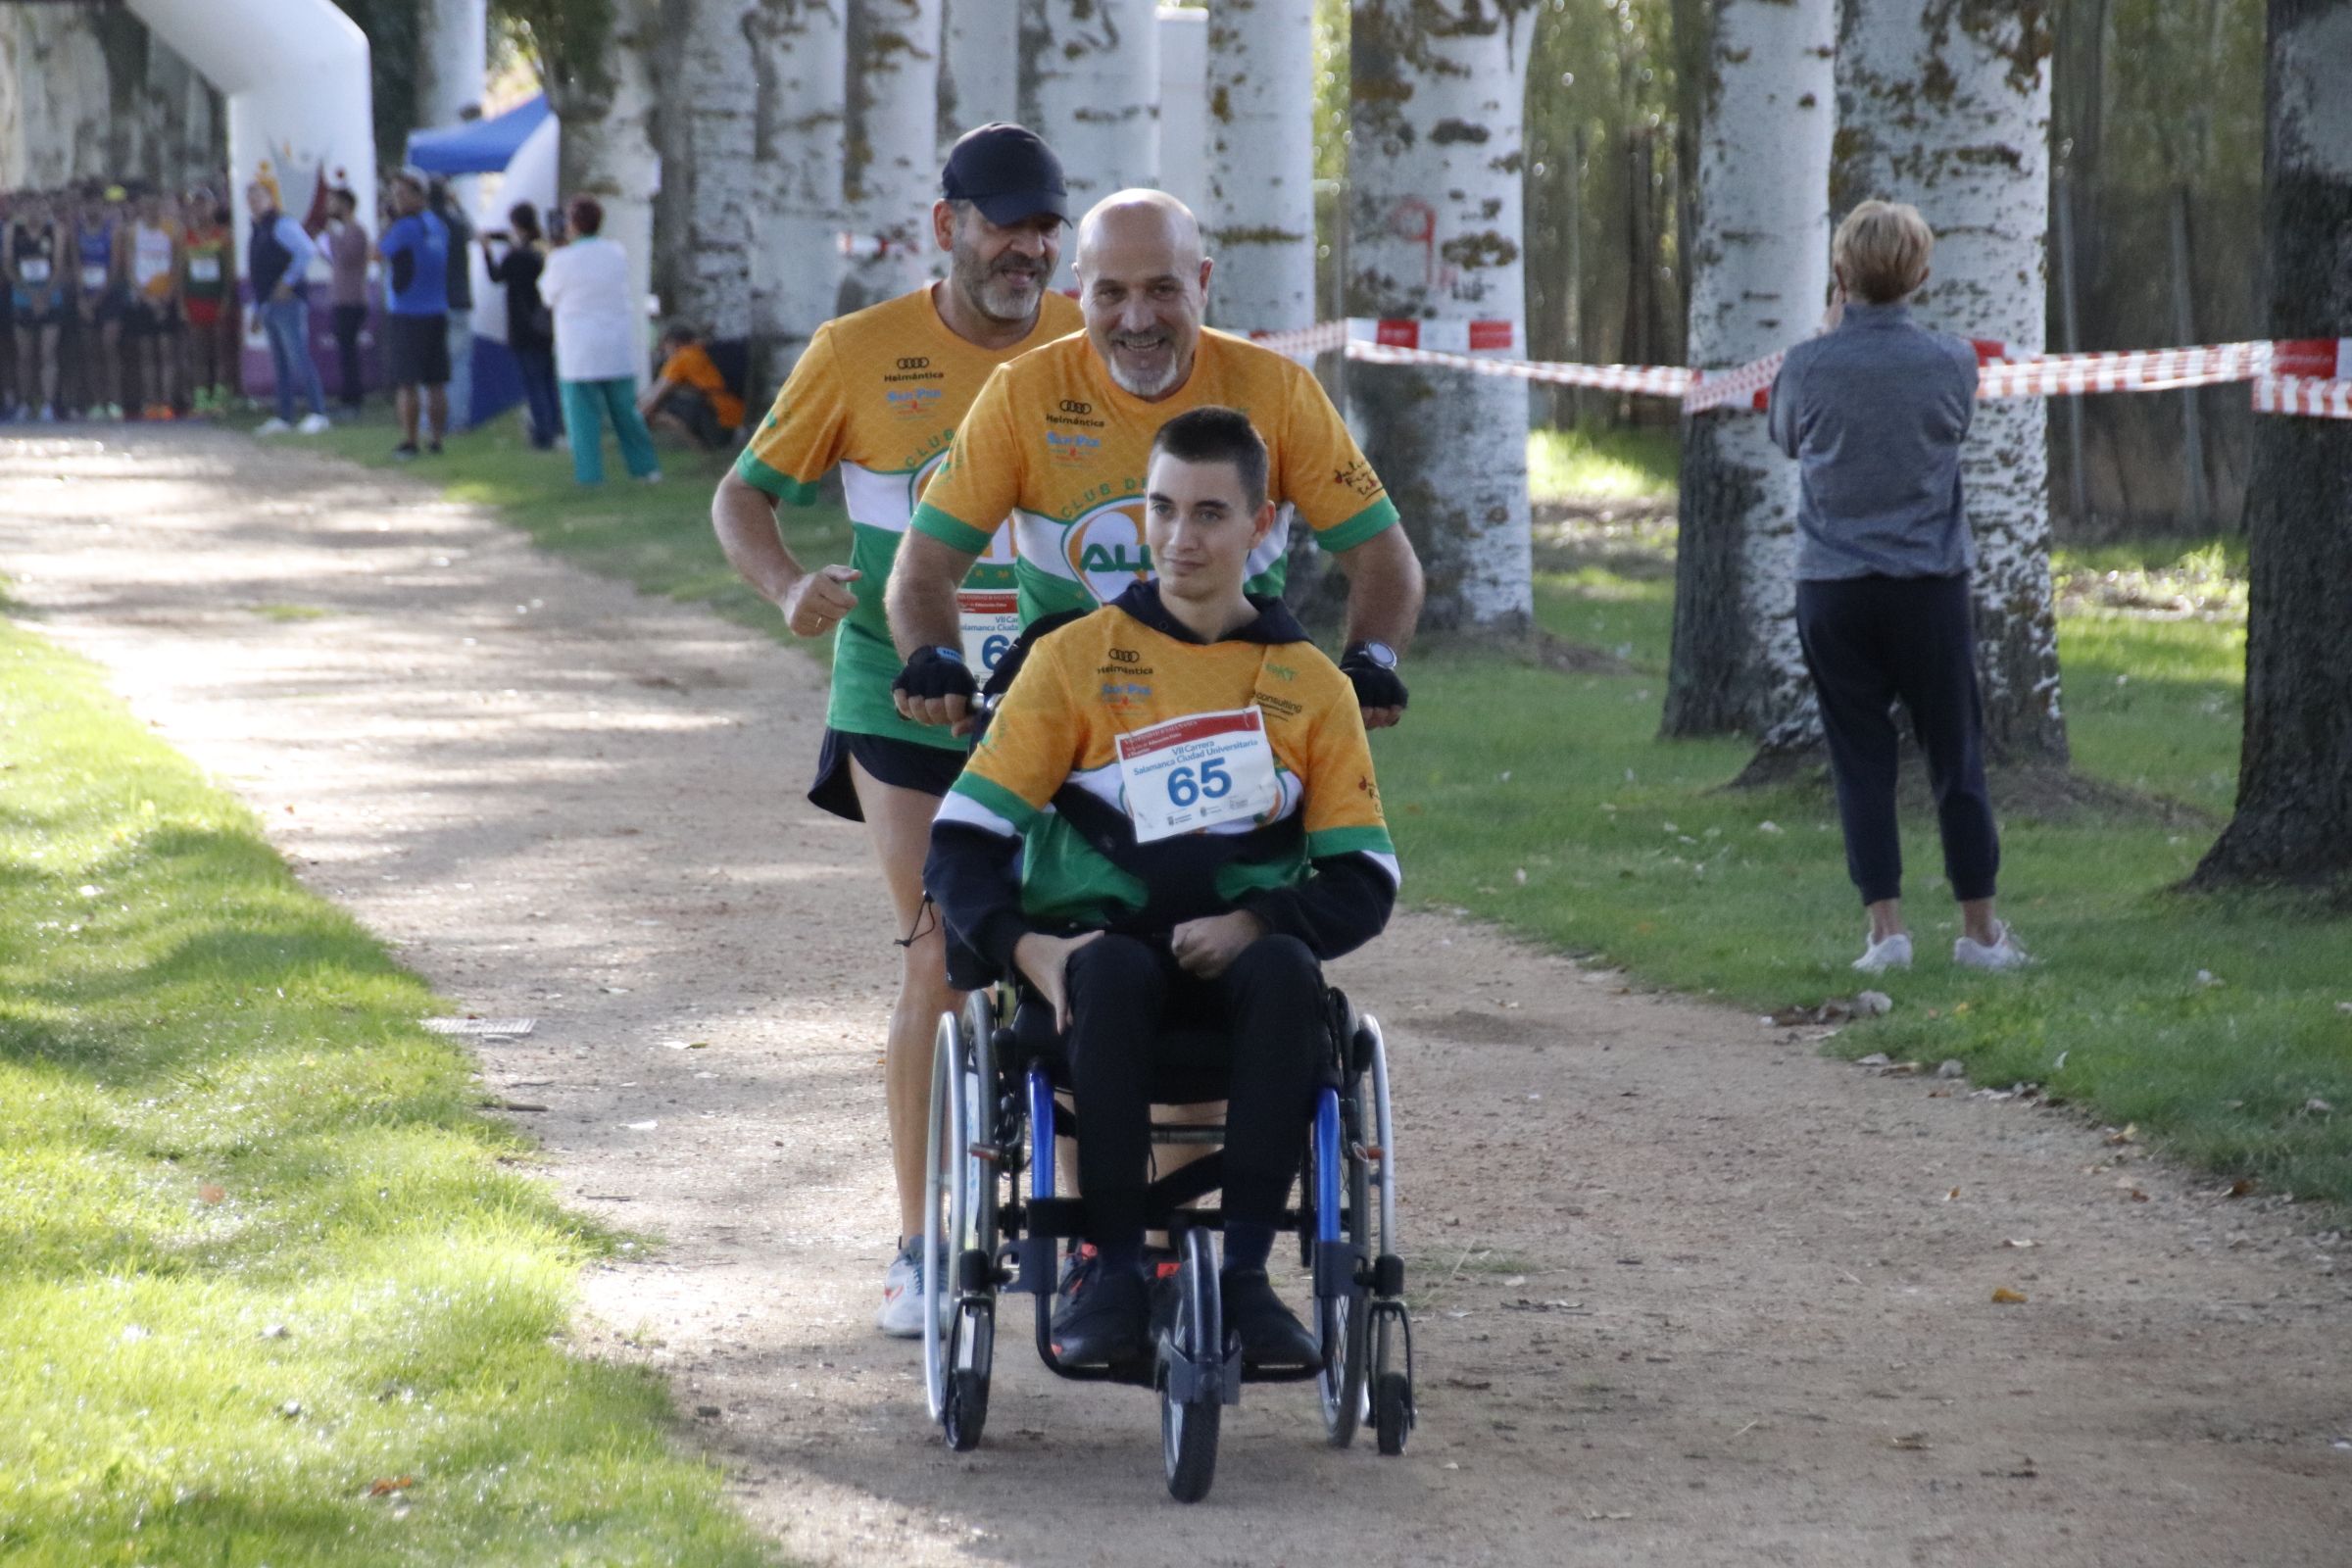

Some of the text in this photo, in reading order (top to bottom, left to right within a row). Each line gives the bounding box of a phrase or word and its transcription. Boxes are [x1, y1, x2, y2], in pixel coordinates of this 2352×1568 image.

[1061, 482, 1111, 518] CLUB
[982, 634, 1010, 670] 6
[1256, 692, 1302, 713] consulting
[1133, 738, 1258, 776] Salamanca Ciudad Universitaria
[1184, 740, 1215, 754] Carrera
[1167, 757, 1233, 808] 65
